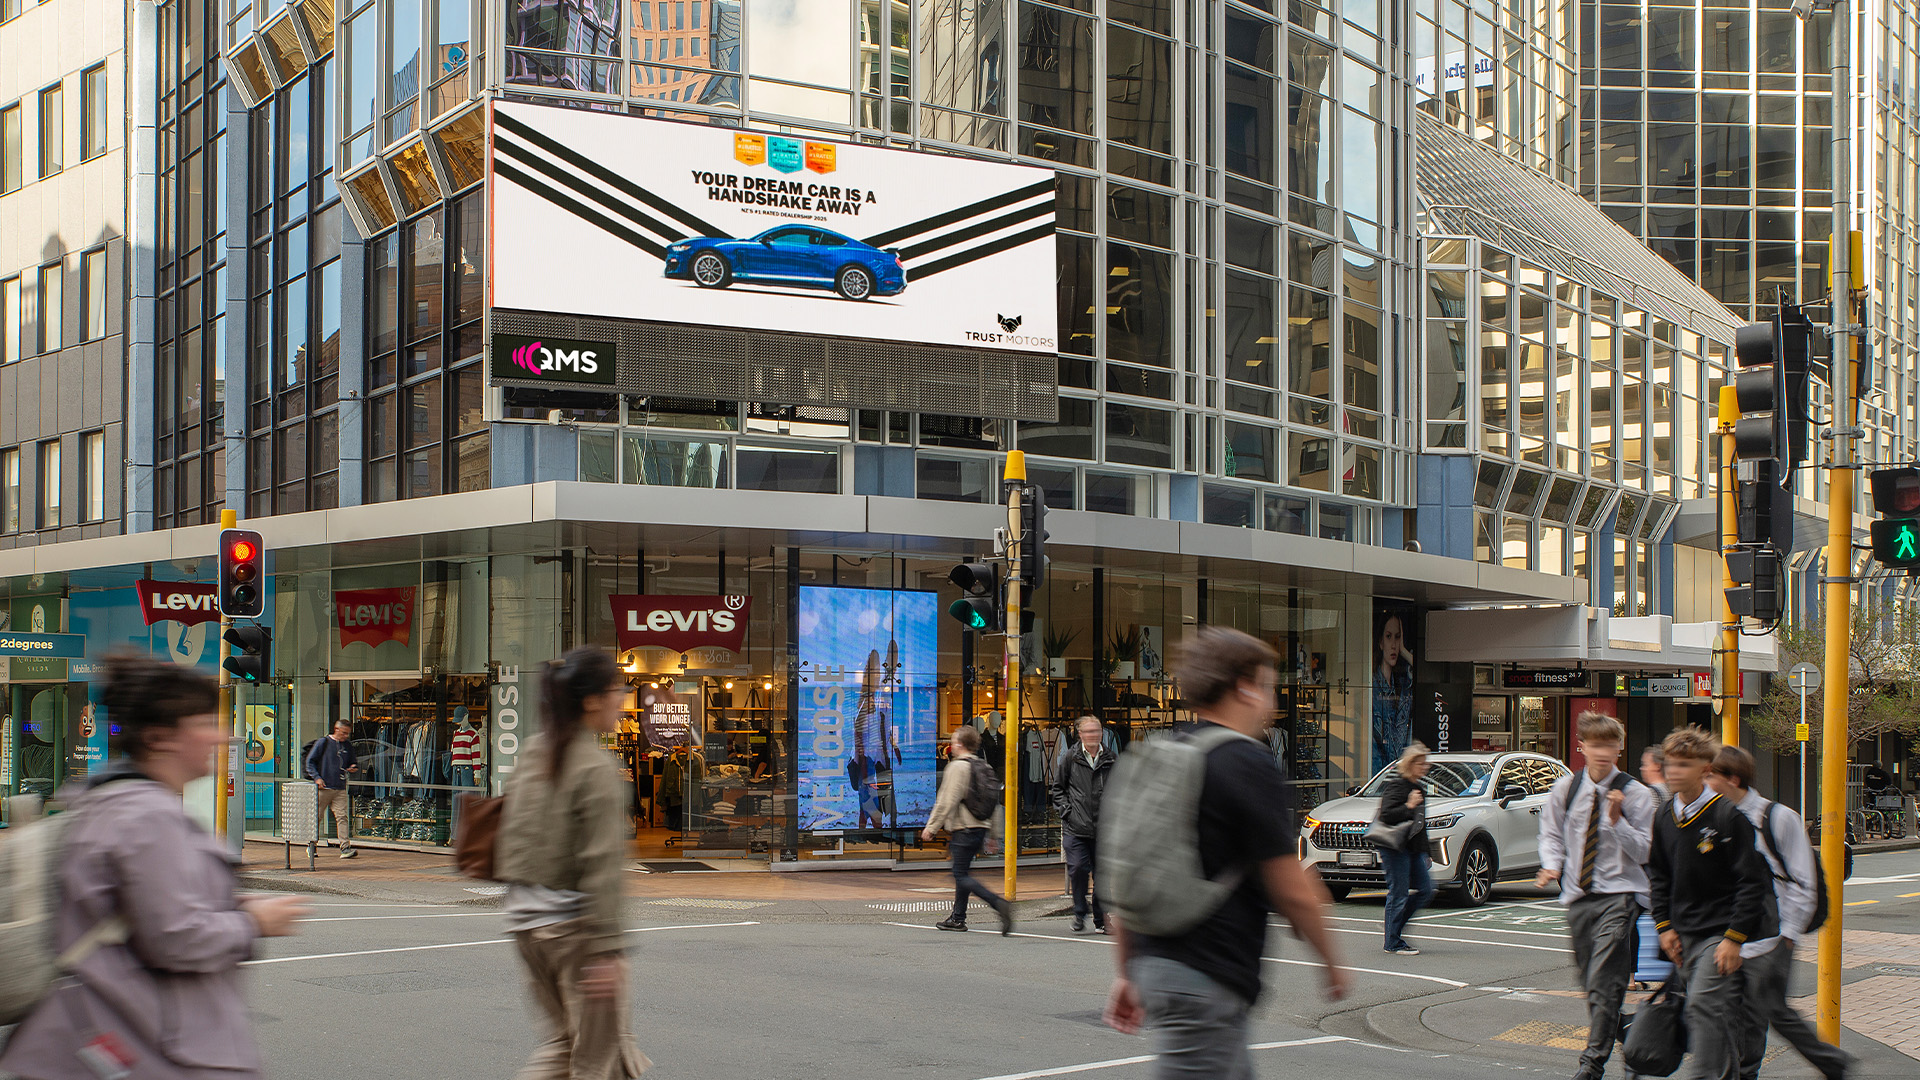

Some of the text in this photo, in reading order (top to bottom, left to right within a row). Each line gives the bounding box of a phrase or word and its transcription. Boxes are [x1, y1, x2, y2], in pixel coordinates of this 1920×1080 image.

[691, 170, 877, 204] YOUR DREAM CAR IS A
[708, 186, 862, 216] HANDSHAKE AWAY
[762, 209, 780, 217] RATED
[780, 211, 813, 220] DEALERSHIP
[965, 331, 1054, 348] TRUST MOTORS
[525, 341, 598, 375] QMS
[0, 638, 54, 651] 2degrees
[1508, 675, 1533, 685] snap
[1533, 672, 1568, 682] fitness
[653, 703, 690, 714] BUY BETTER.
[497, 665, 519, 774] LOOSE
[649, 714, 668, 724] WEAR
[1478, 711, 1501, 725] fitness
[813, 664, 845, 856] LIVE LOOSE
